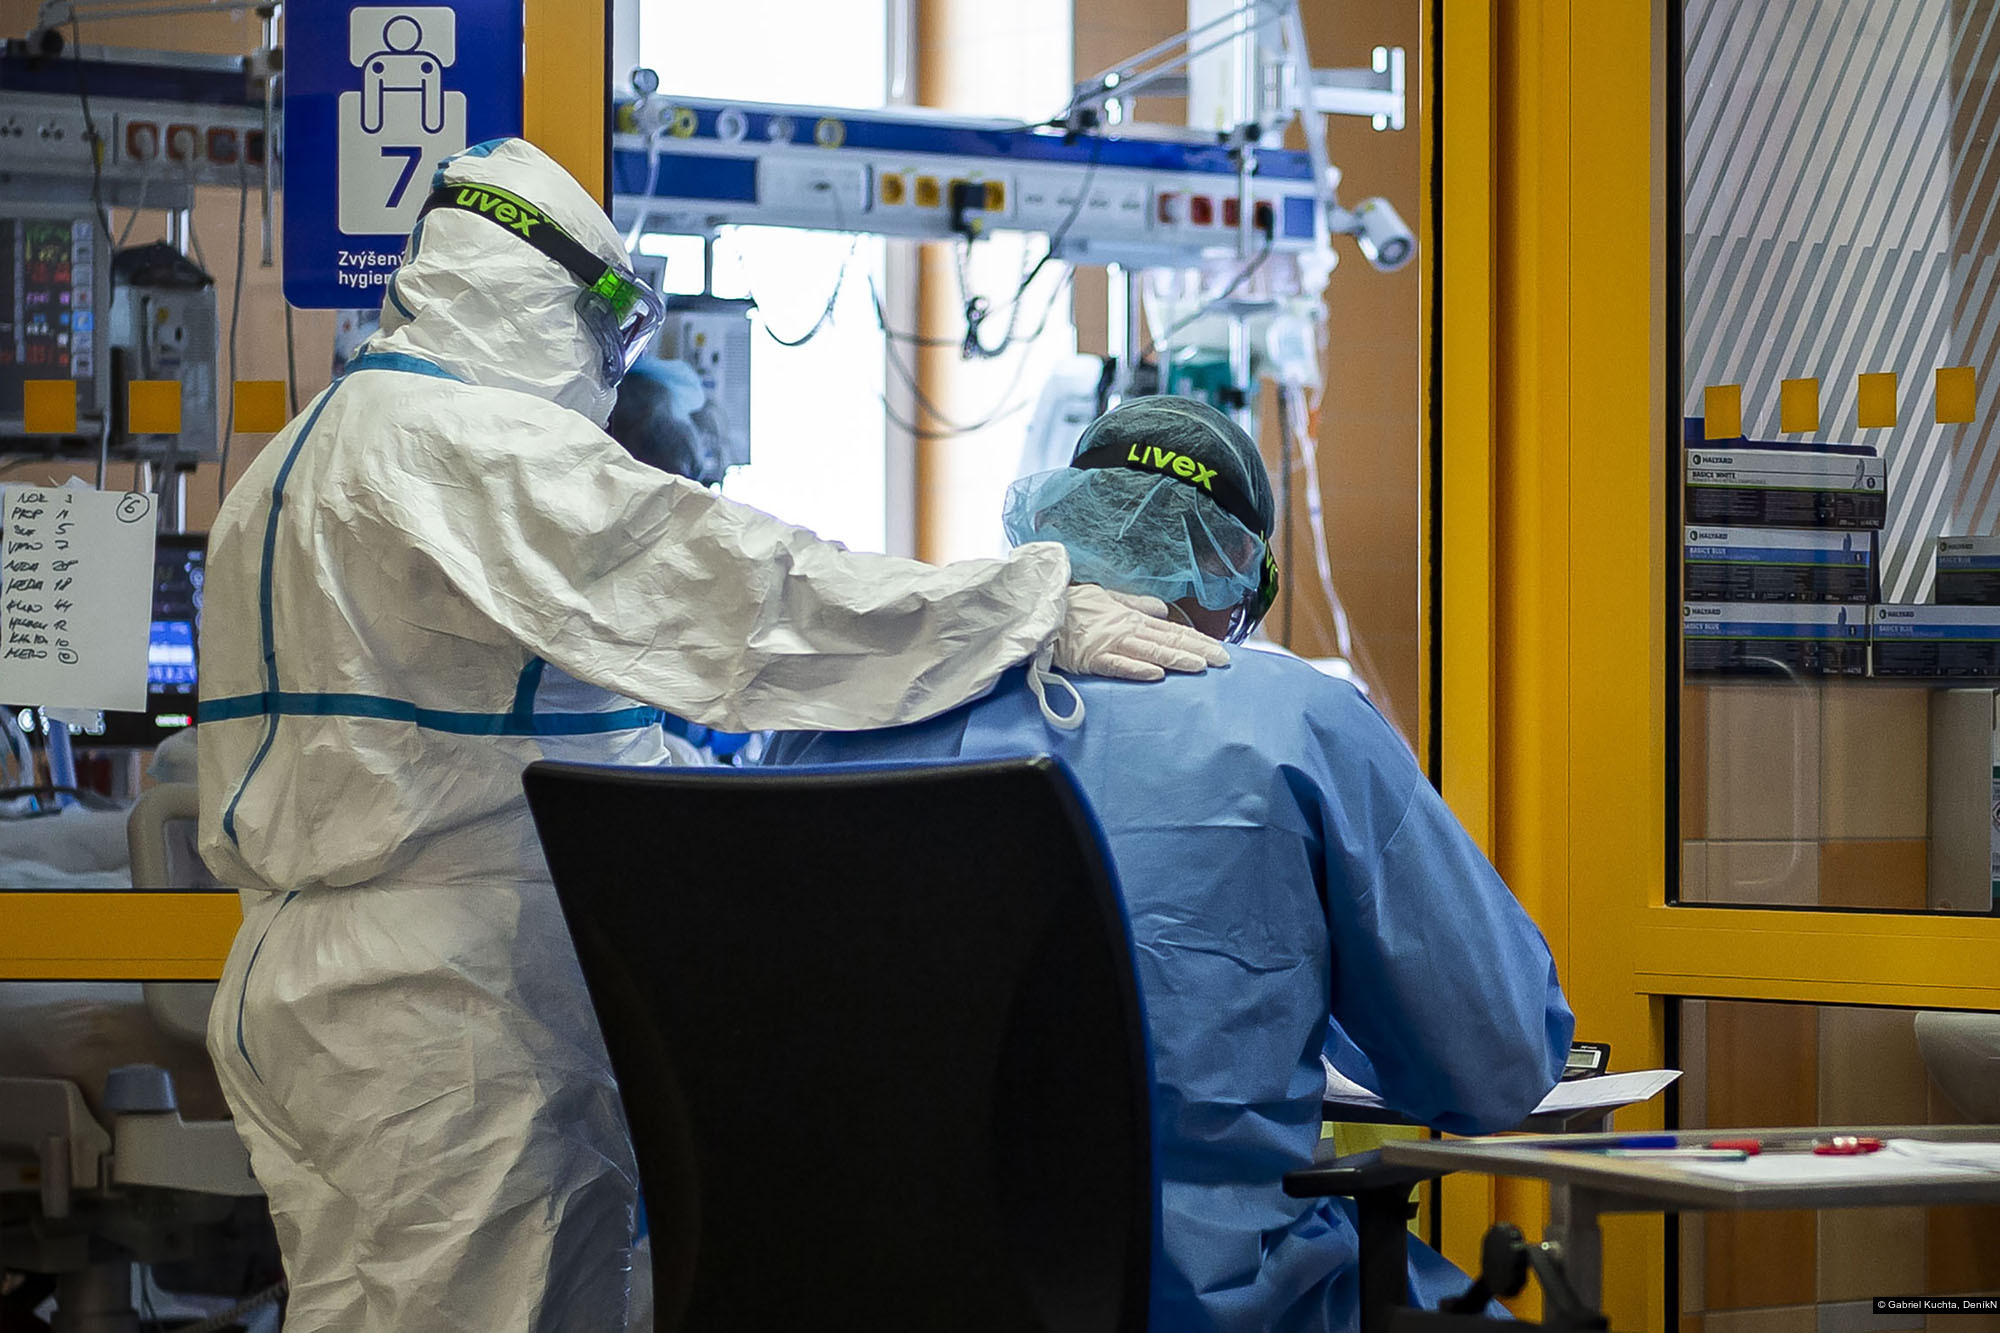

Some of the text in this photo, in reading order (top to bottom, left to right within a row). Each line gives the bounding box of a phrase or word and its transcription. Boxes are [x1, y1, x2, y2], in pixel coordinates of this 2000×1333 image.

[381, 146, 422, 208] 7
[456, 188, 540, 238] uvex
[1702, 456, 1733, 464] HALYARD
[55, 523, 75, 535] 5
